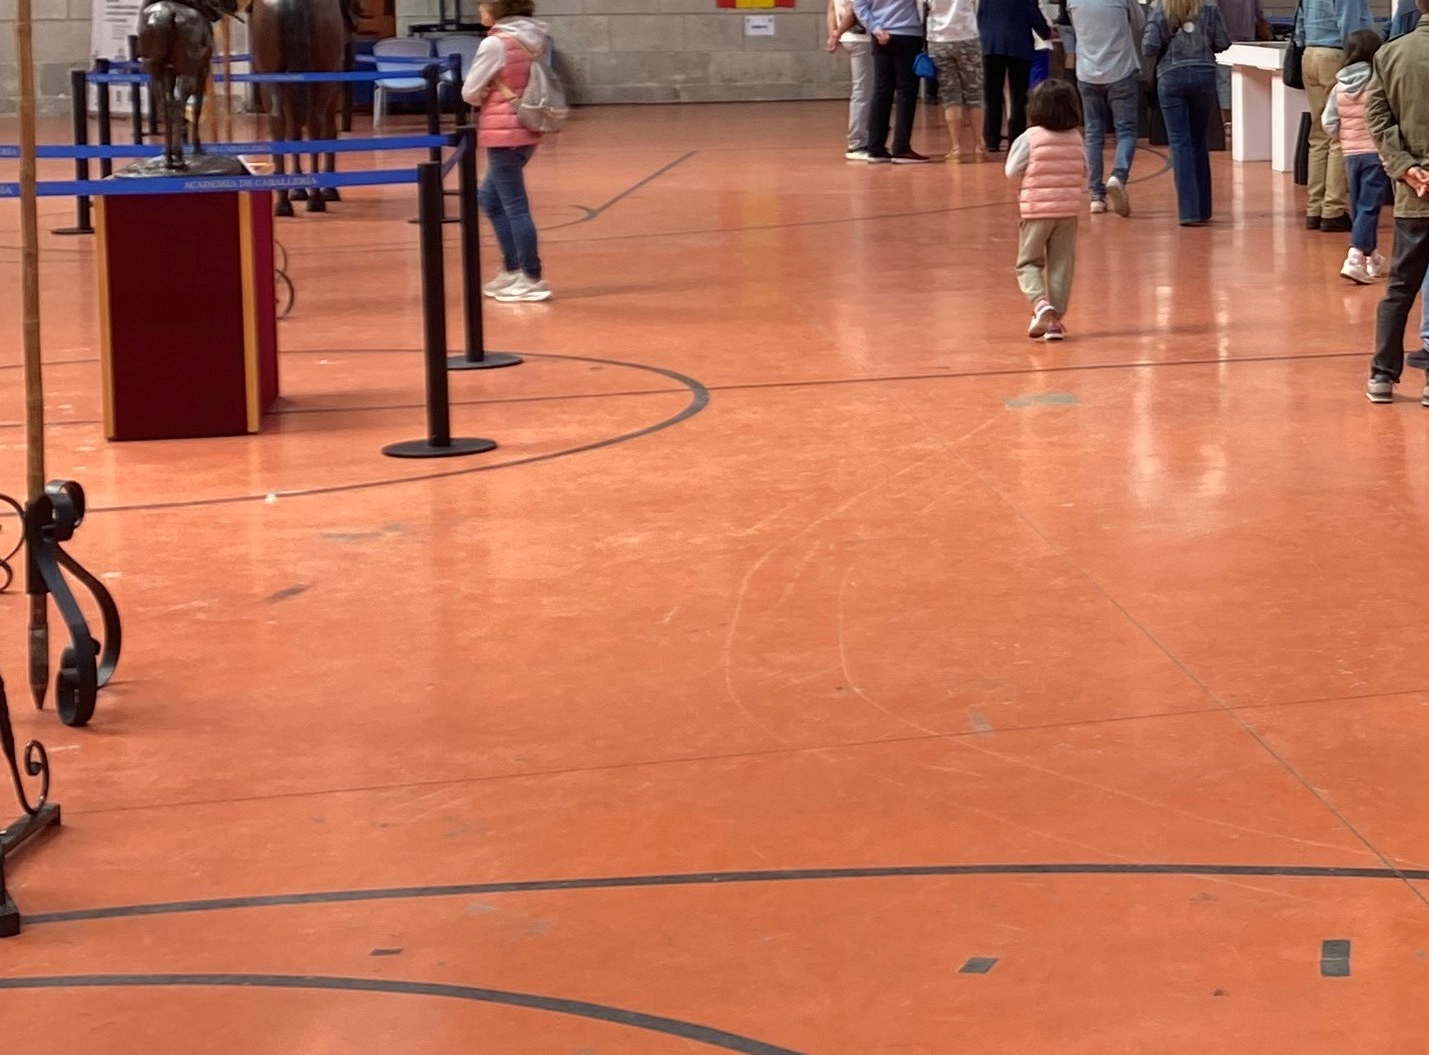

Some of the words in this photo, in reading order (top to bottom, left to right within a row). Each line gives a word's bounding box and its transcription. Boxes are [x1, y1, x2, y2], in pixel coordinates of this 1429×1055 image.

[184, 179, 238, 190] ACADEMIA
[240, 178, 253, 188] DE
[255, 176, 317, 187] CABALLERÍA
